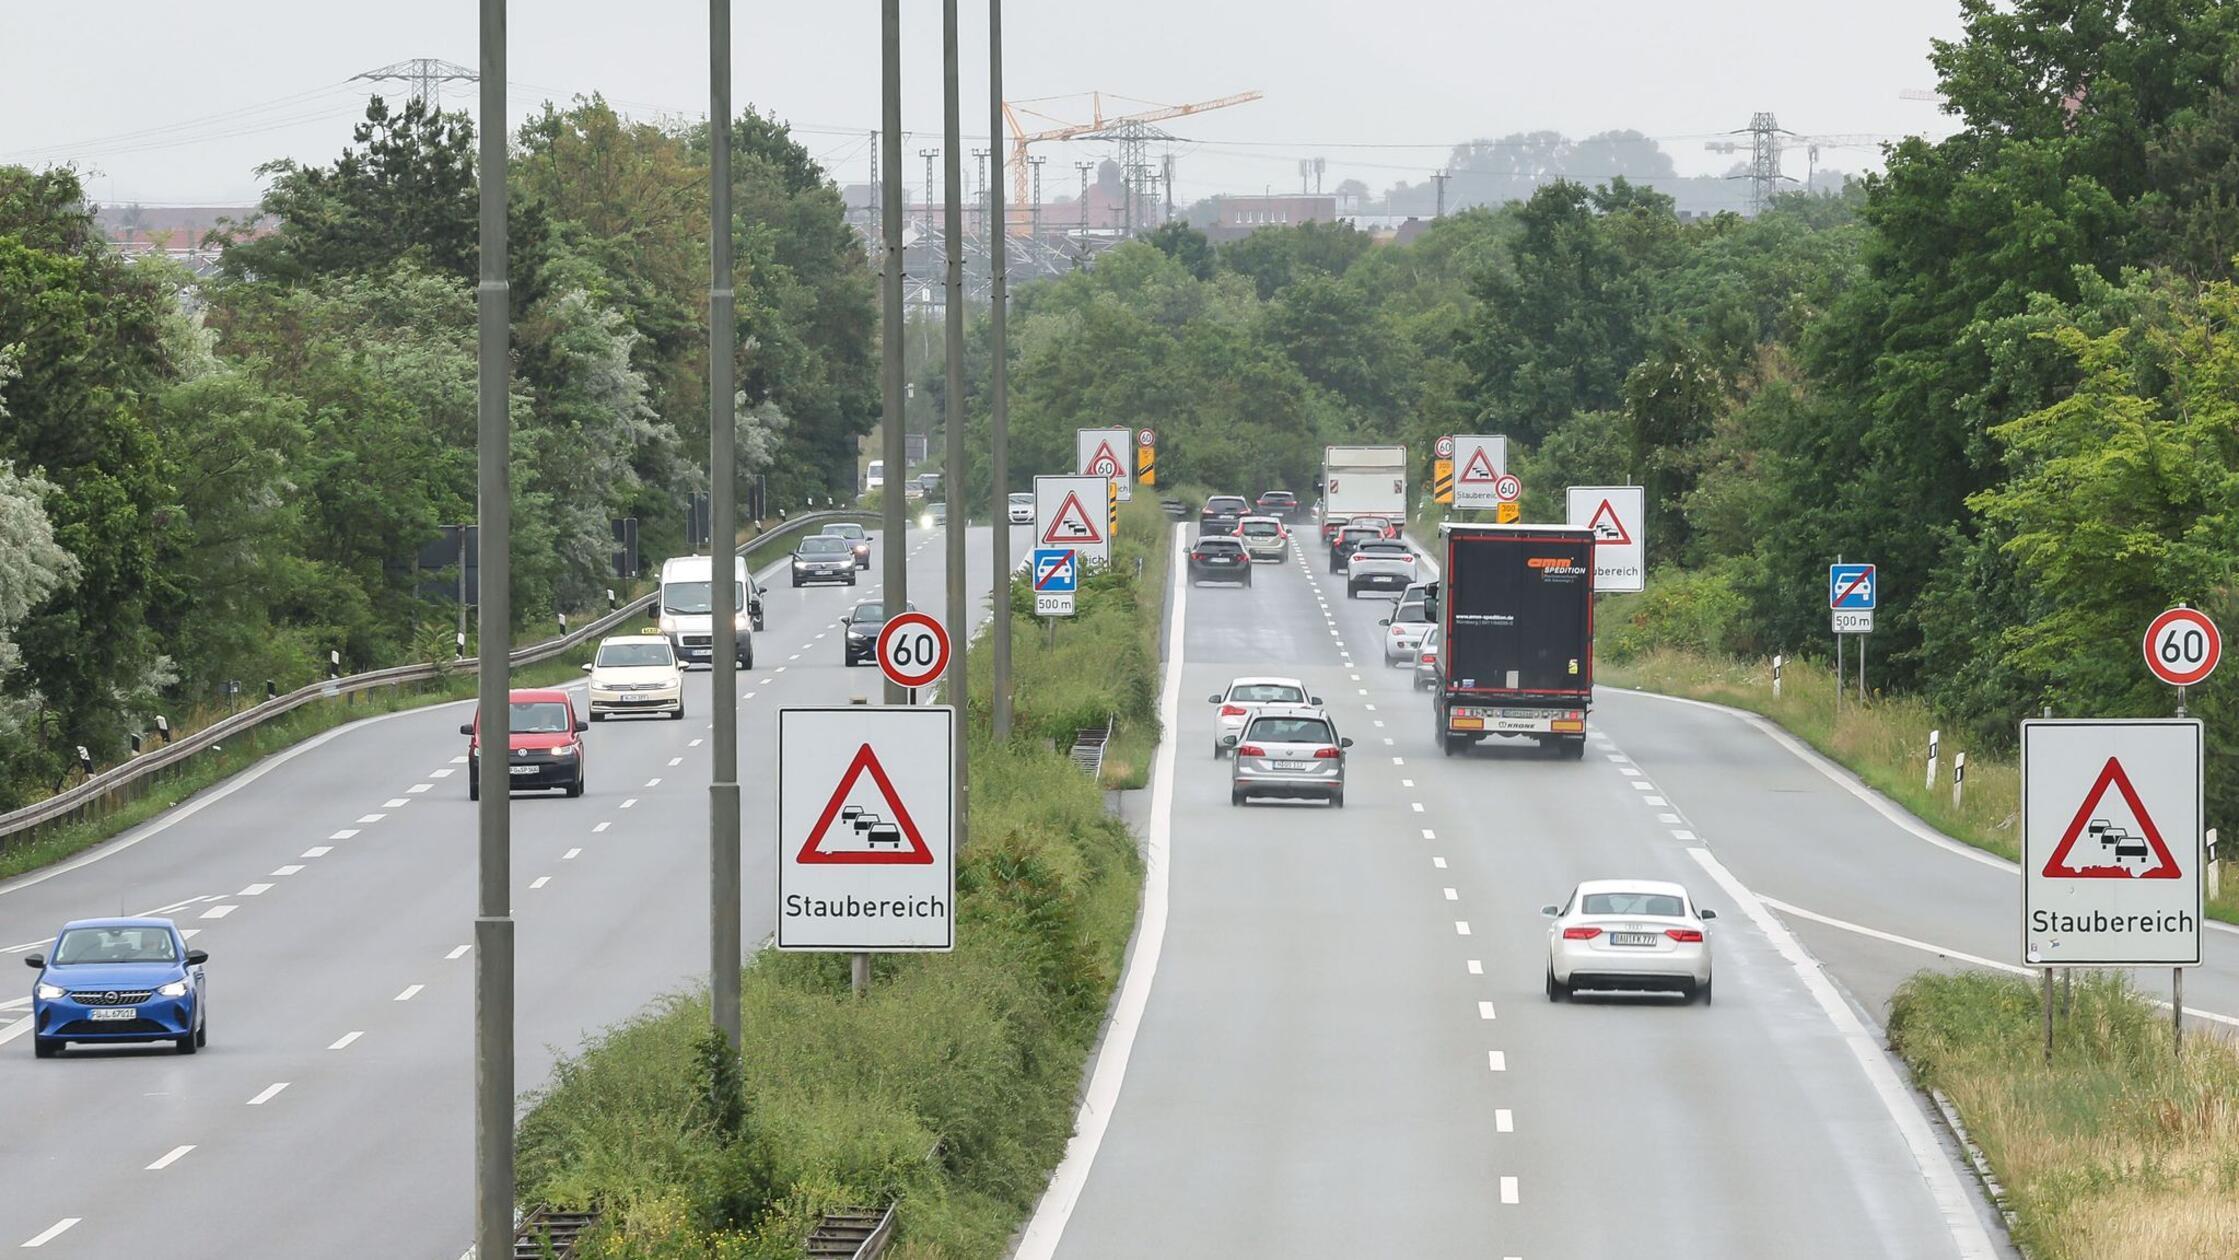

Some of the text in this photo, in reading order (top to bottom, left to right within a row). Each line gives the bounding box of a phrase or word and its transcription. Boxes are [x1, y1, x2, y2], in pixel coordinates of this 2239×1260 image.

[1141, 434, 1152, 443] 60
[1439, 442, 1452, 452] 60
[1098, 462, 1113, 474] 60
[1500, 482, 1515, 494] 60
[1038, 599, 1071, 609] 500 m
[1836, 616, 1869, 626] 500 m
[893, 633, 934, 667] 60
[2161, 629, 2204, 663] 60
[785, 894, 945, 918] Staubereich
[2032, 909, 2193, 933] Staubereich
